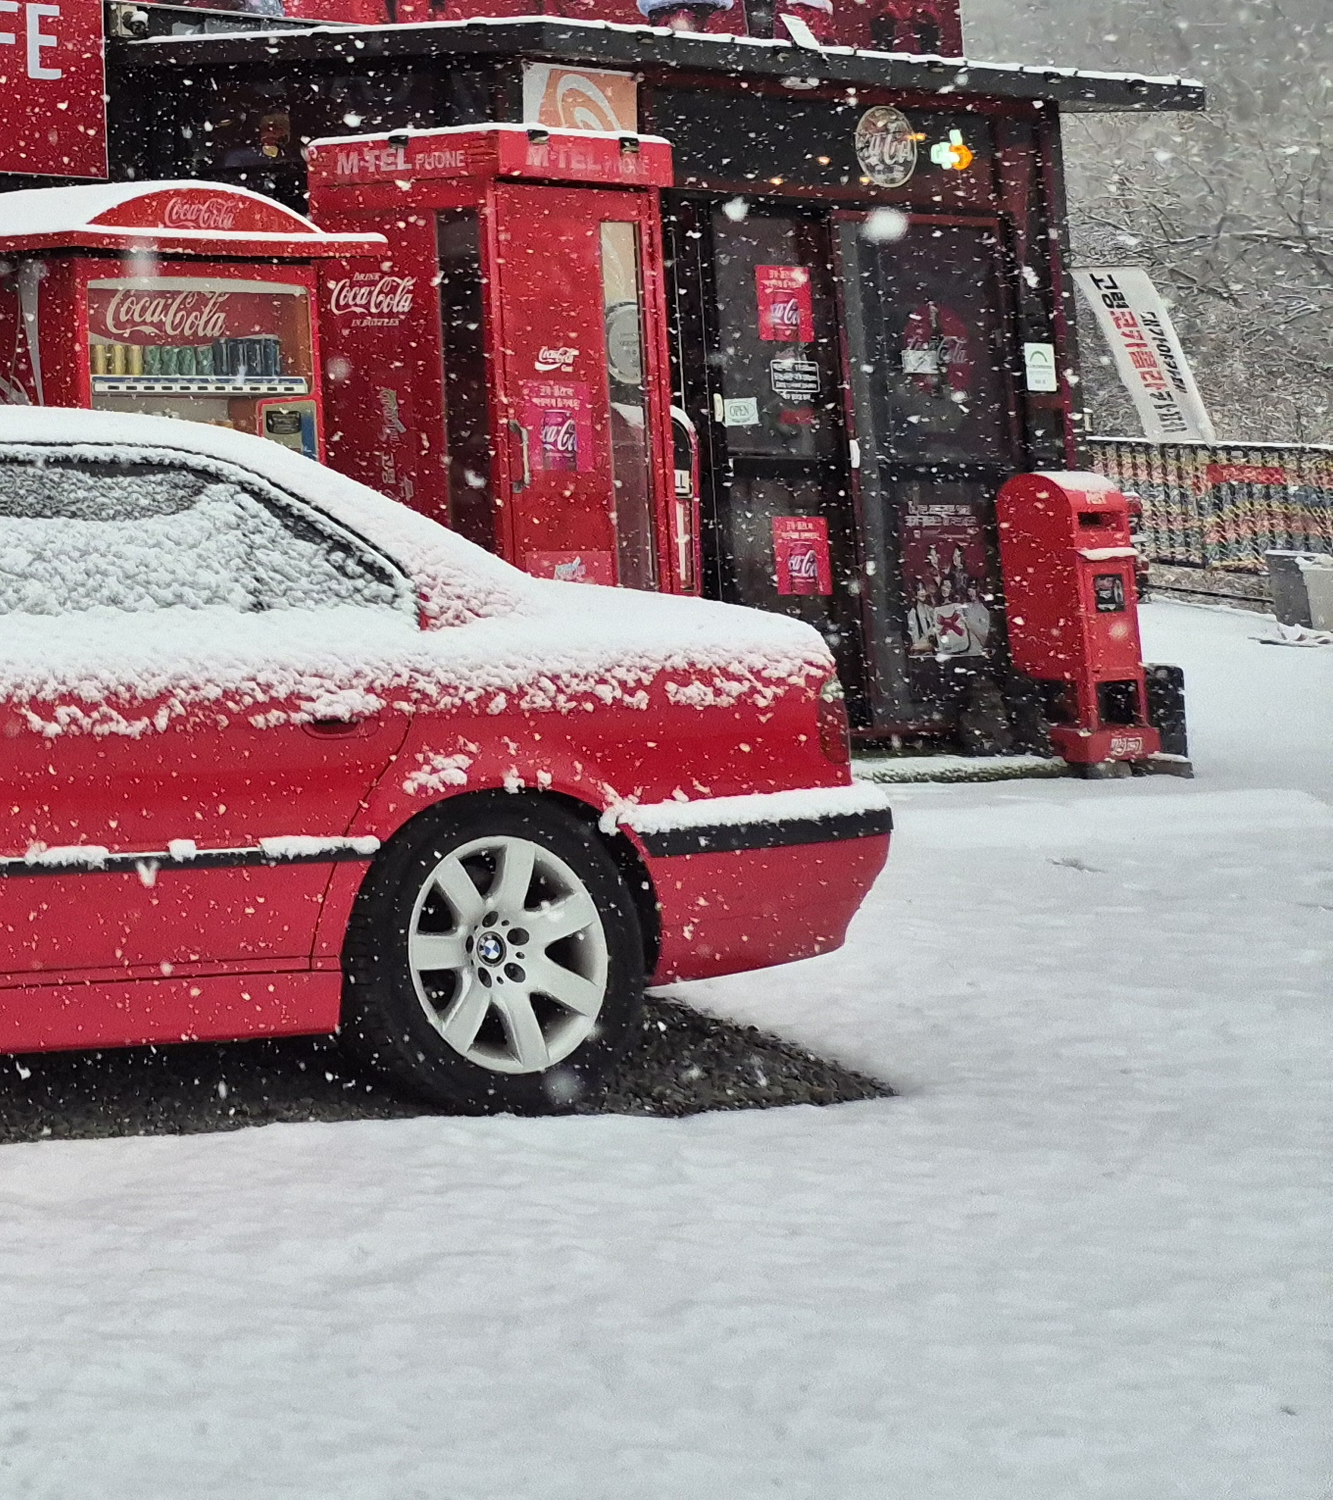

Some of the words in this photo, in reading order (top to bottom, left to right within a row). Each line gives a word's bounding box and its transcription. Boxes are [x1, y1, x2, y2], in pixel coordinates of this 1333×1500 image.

[415, 151, 467, 172] PHONE
[164, 197, 235, 229] Coca-Cola
[353, 272, 382, 281] DRINK
[330, 276, 417, 315] Coca-Cola
[106, 288, 231, 337] Coca-Cola
